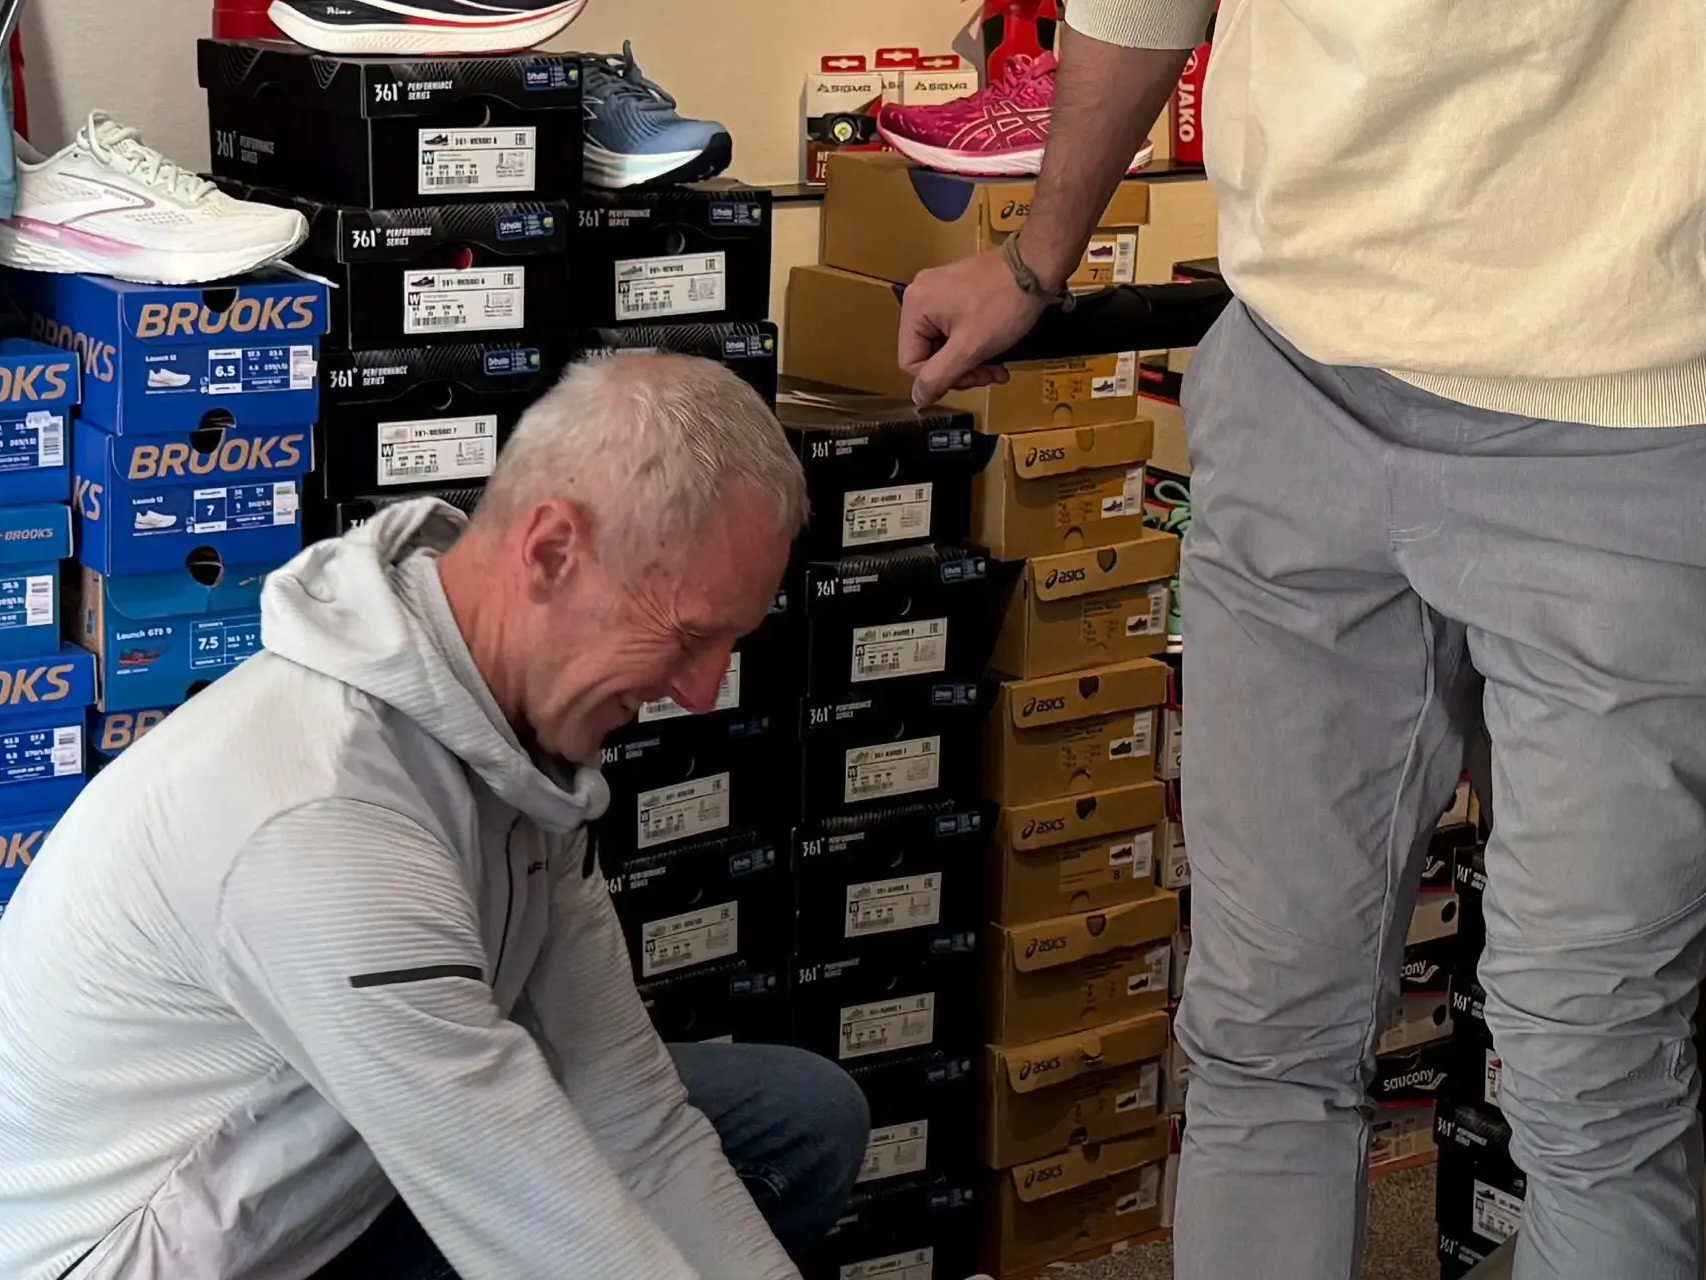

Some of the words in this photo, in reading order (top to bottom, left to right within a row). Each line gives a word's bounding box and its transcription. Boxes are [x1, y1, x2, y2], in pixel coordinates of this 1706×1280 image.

[408, 80, 453, 91] PERFORMANCE
[408, 90, 431, 101] SERIES
[1177, 81, 1195, 143] JAKO
[386, 226, 432, 238] PERFORMANCE
[386, 236, 409, 246] SERIES
[136, 295, 318, 339] BROOKS
[215, 366, 235, 377] 6.5
[128, 434, 305, 480] BROOKS
[1039, 448, 1065, 462] asics
[5, 528, 53, 541] BROOKS
[1059, 568, 1085, 583] asics
[198, 636, 219, 650] 7.5
[1037, 697, 1065, 712] asics
[1037, 819, 1065, 834] asics
[1038, 937, 1067, 952] asics
